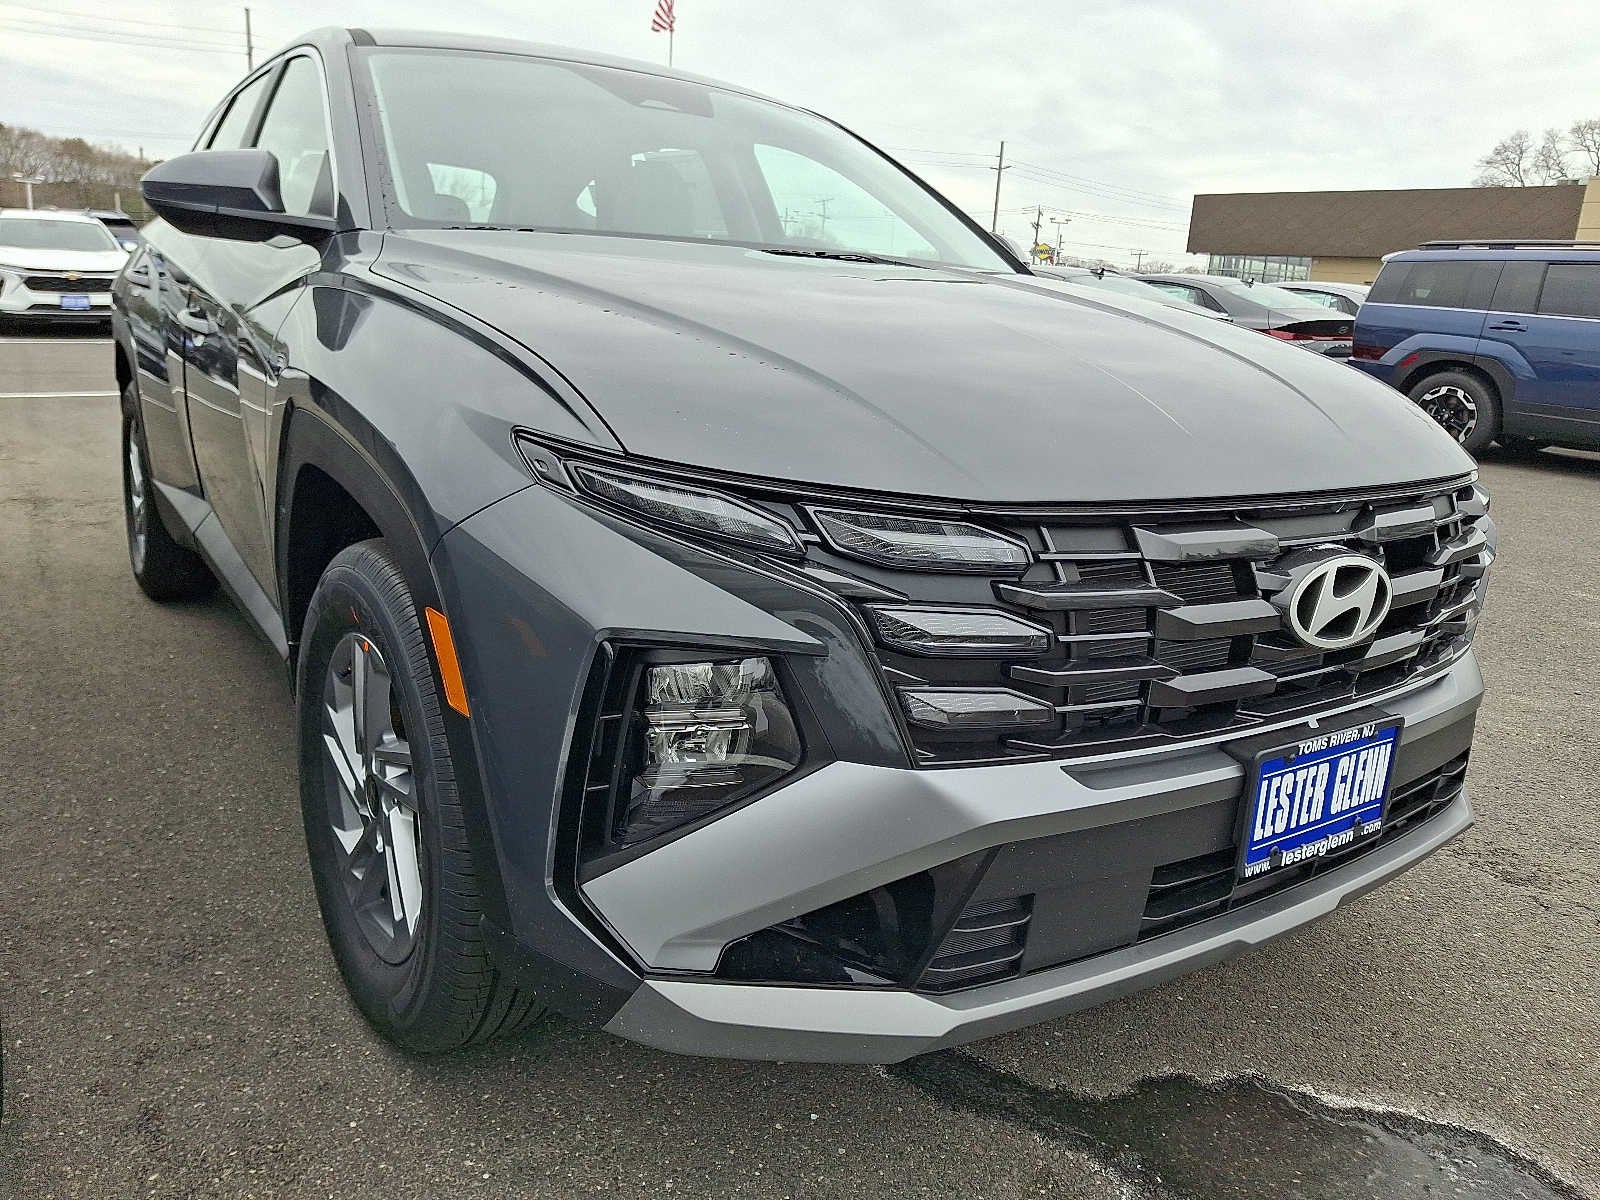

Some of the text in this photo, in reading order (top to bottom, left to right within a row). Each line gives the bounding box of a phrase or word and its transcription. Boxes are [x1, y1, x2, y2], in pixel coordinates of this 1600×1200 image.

[1298, 738, 1328, 755] TOMS
[1329, 729, 1360, 747] RIVER,
[1254, 744, 1392, 841] LESTER GLENN
[1281, 832, 1353, 866] lesterglenn
